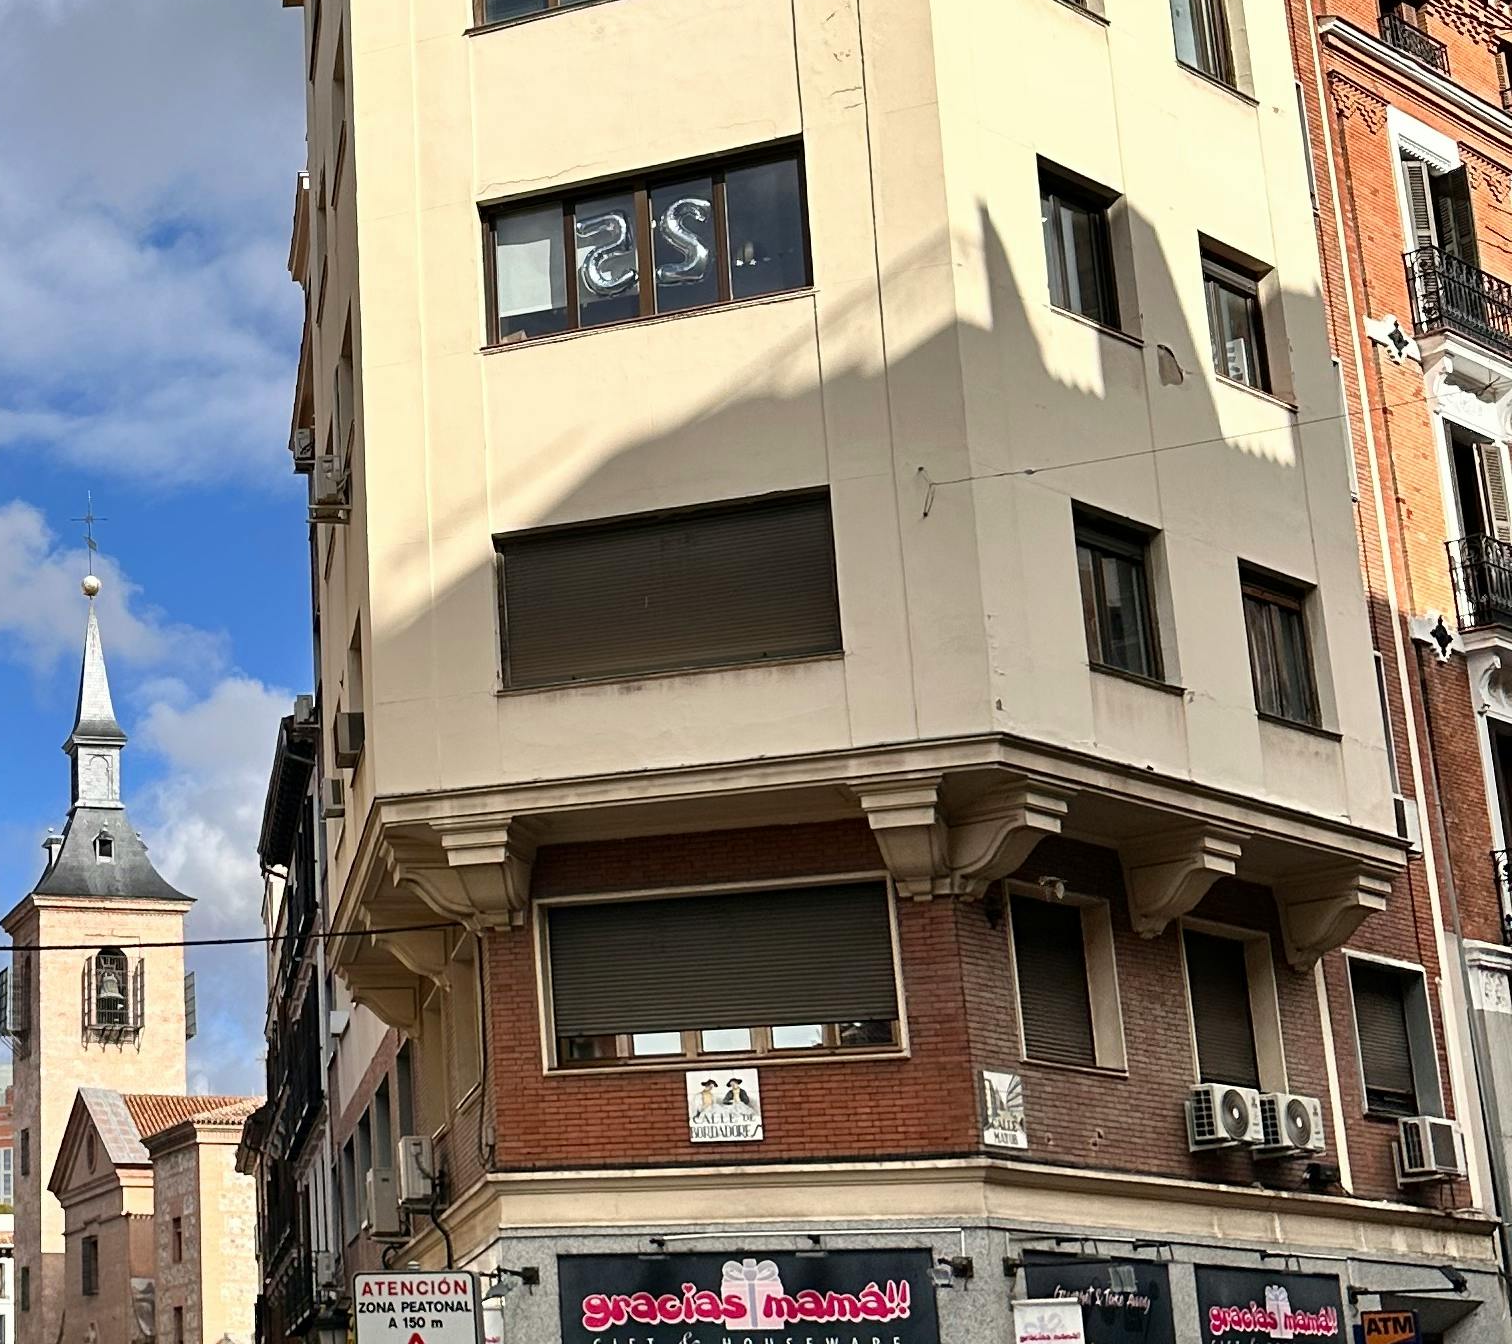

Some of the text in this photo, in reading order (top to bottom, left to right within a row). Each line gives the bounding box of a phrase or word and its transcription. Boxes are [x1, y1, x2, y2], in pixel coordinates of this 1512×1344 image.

[692, 1112, 736, 1124] CALLE
[691, 1124, 763, 1138] BORDADORES
[361, 1277, 468, 1296] ATENCIÓN
[358, 1301, 472, 1313] ZONA PEATONAL
[583, 1280, 910, 1331] gracias mamá!!
[388, 1317, 443, 1328] A 150 m
[1209, 1301, 1338, 1337] gracias mamá!!
[1367, 1316, 1414, 1336] ATM
